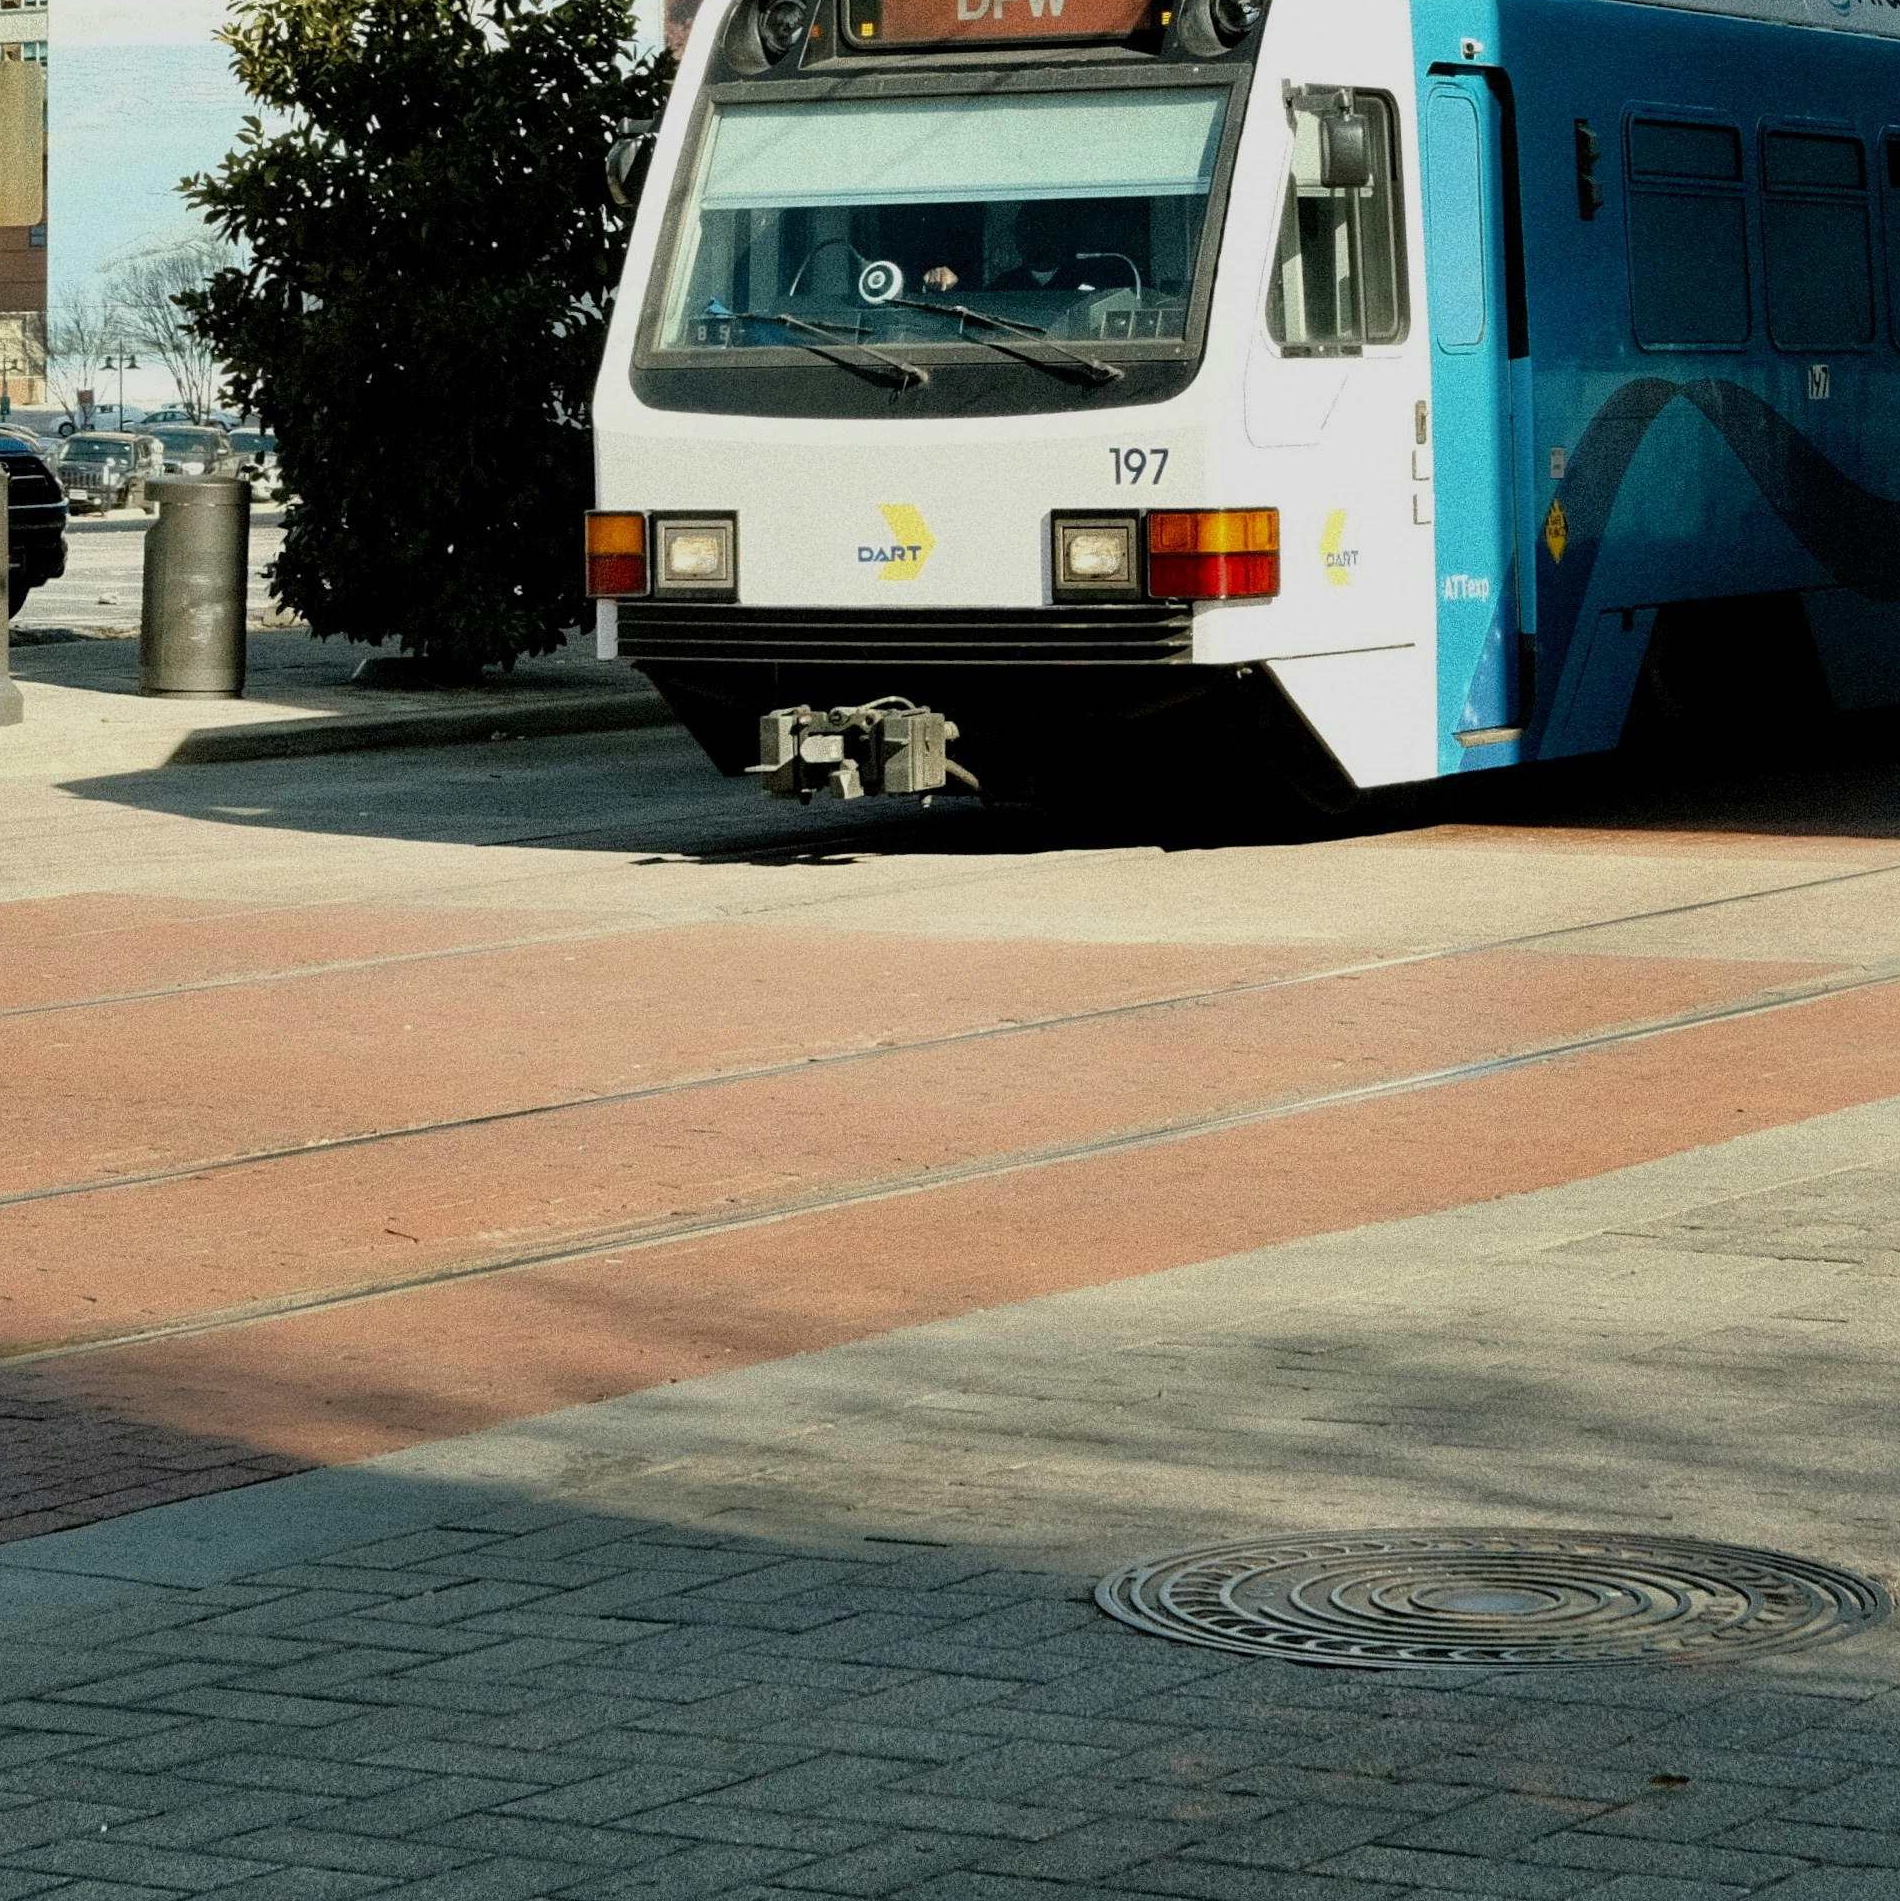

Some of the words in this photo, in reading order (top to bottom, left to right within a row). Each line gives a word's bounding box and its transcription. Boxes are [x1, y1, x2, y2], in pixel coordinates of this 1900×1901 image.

[1109, 447, 1169, 485] 197
[857, 545, 922, 563] DART
[1326, 549, 1359, 567] DART
